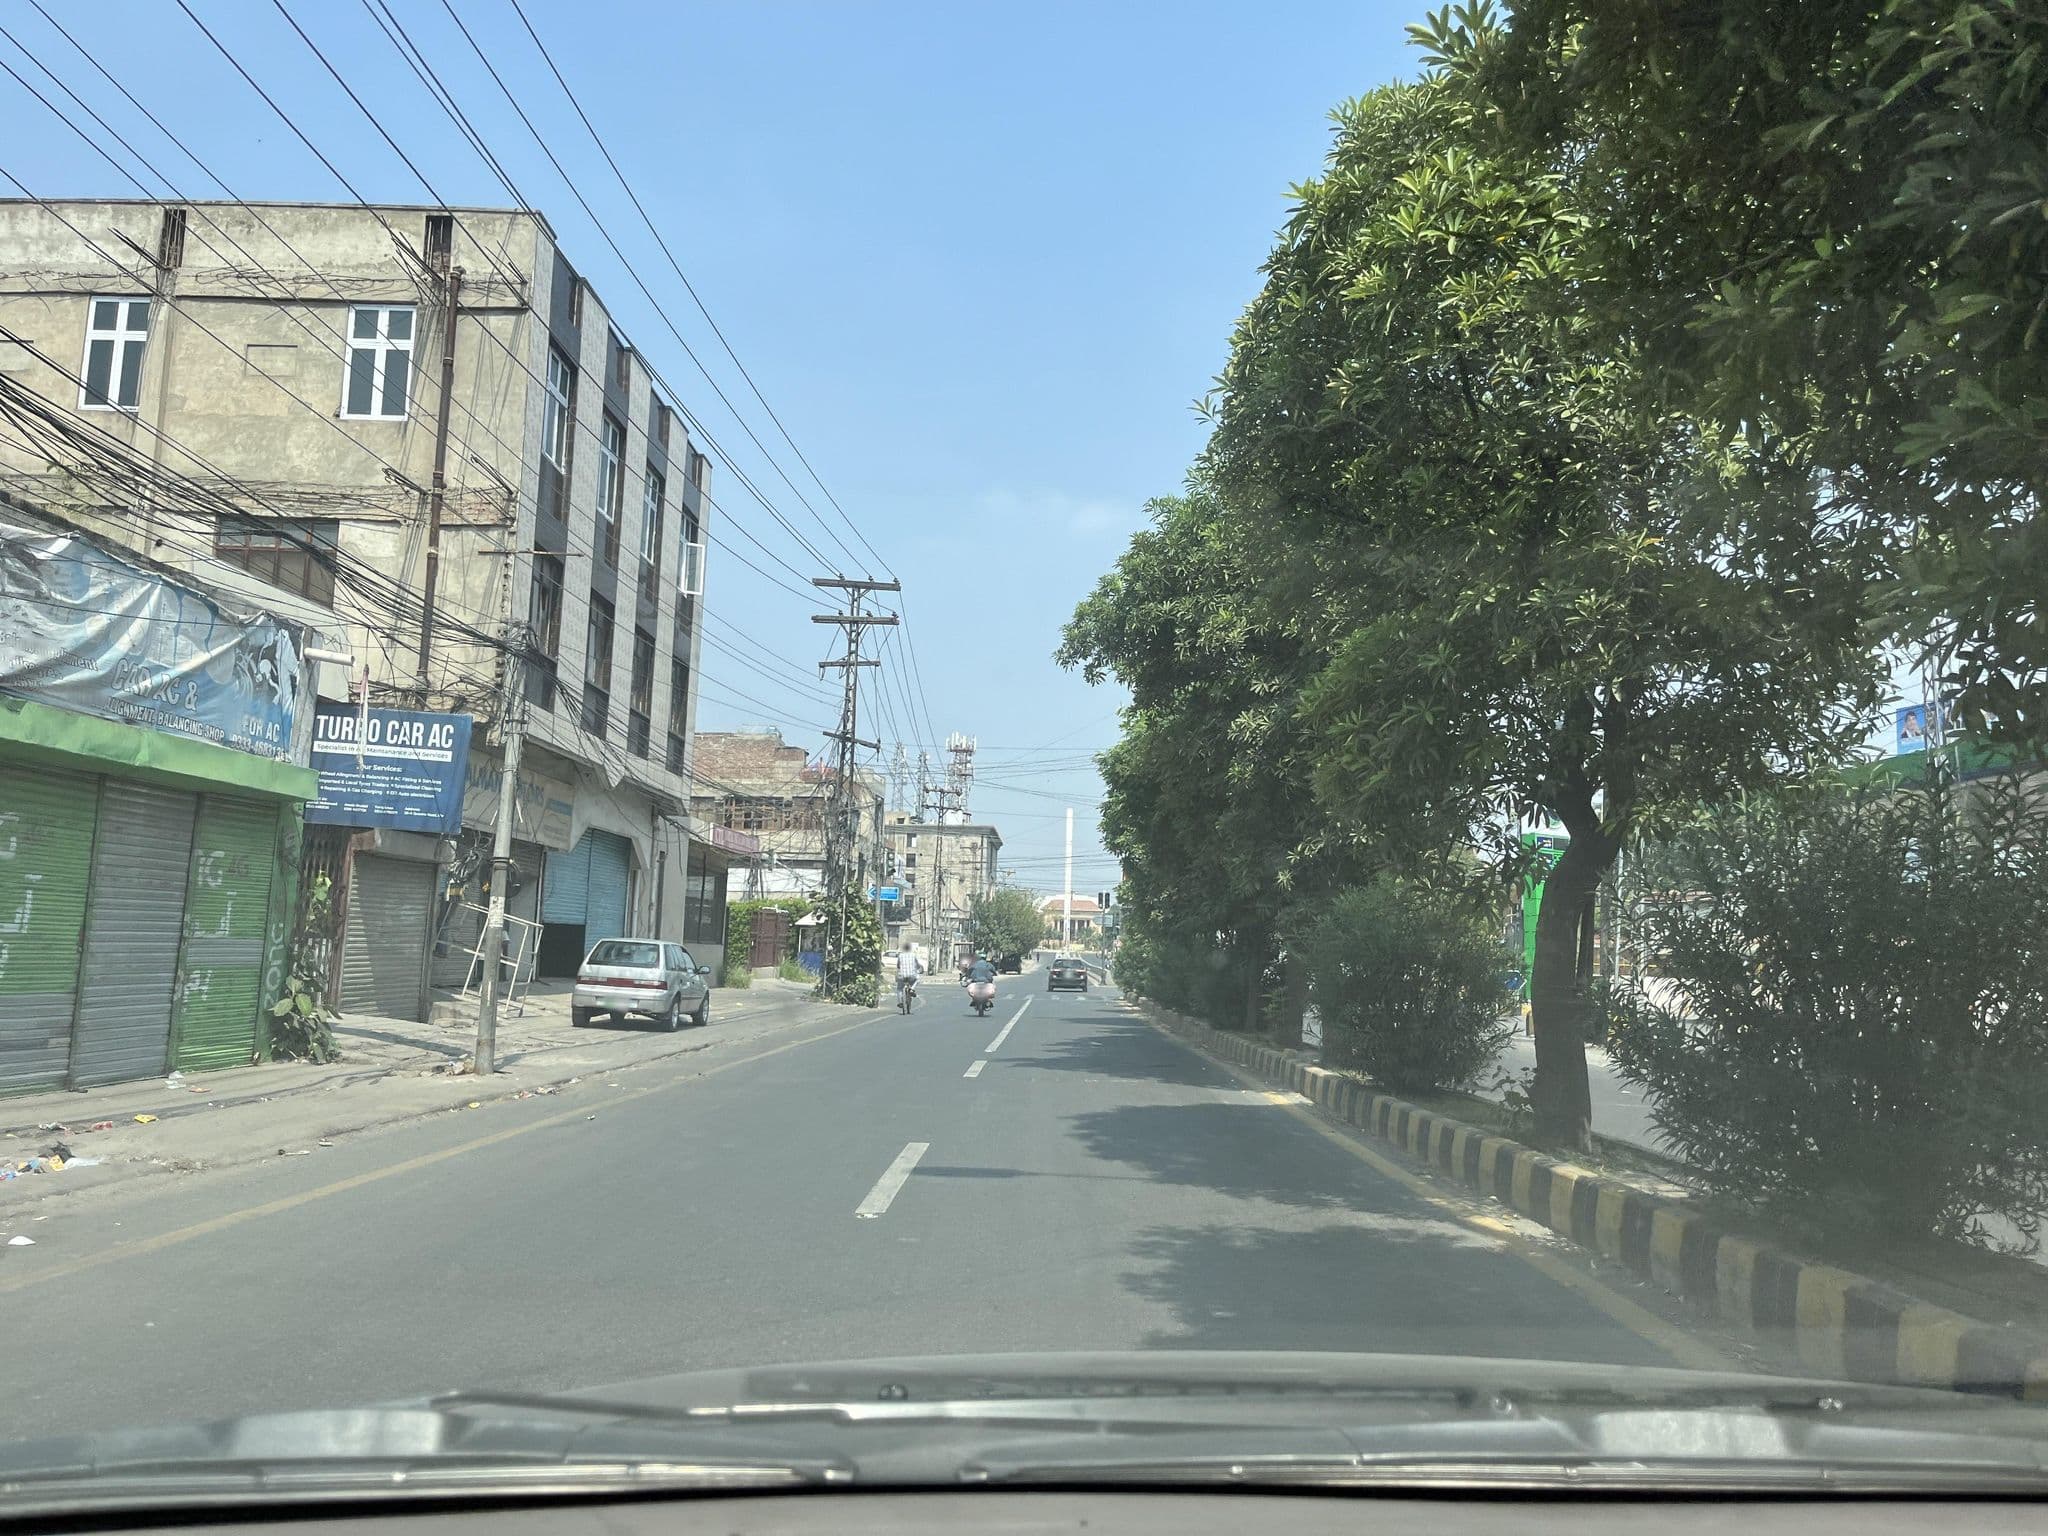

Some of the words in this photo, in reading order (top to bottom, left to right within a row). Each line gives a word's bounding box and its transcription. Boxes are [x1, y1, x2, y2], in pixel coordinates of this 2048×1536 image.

[152, 674, 181, 705] AC
[184, 680, 198, 711] &
[157, 711, 203, 736] BALANCING
[204, 725, 225, 742] SHOP
[265, 721, 280, 743] AC
[386, 720, 425, 747] CAR
[427, 723, 455, 749] AC
[317, 743, 347, 751] Specialist
[372, 765, 402, 773] Services:
